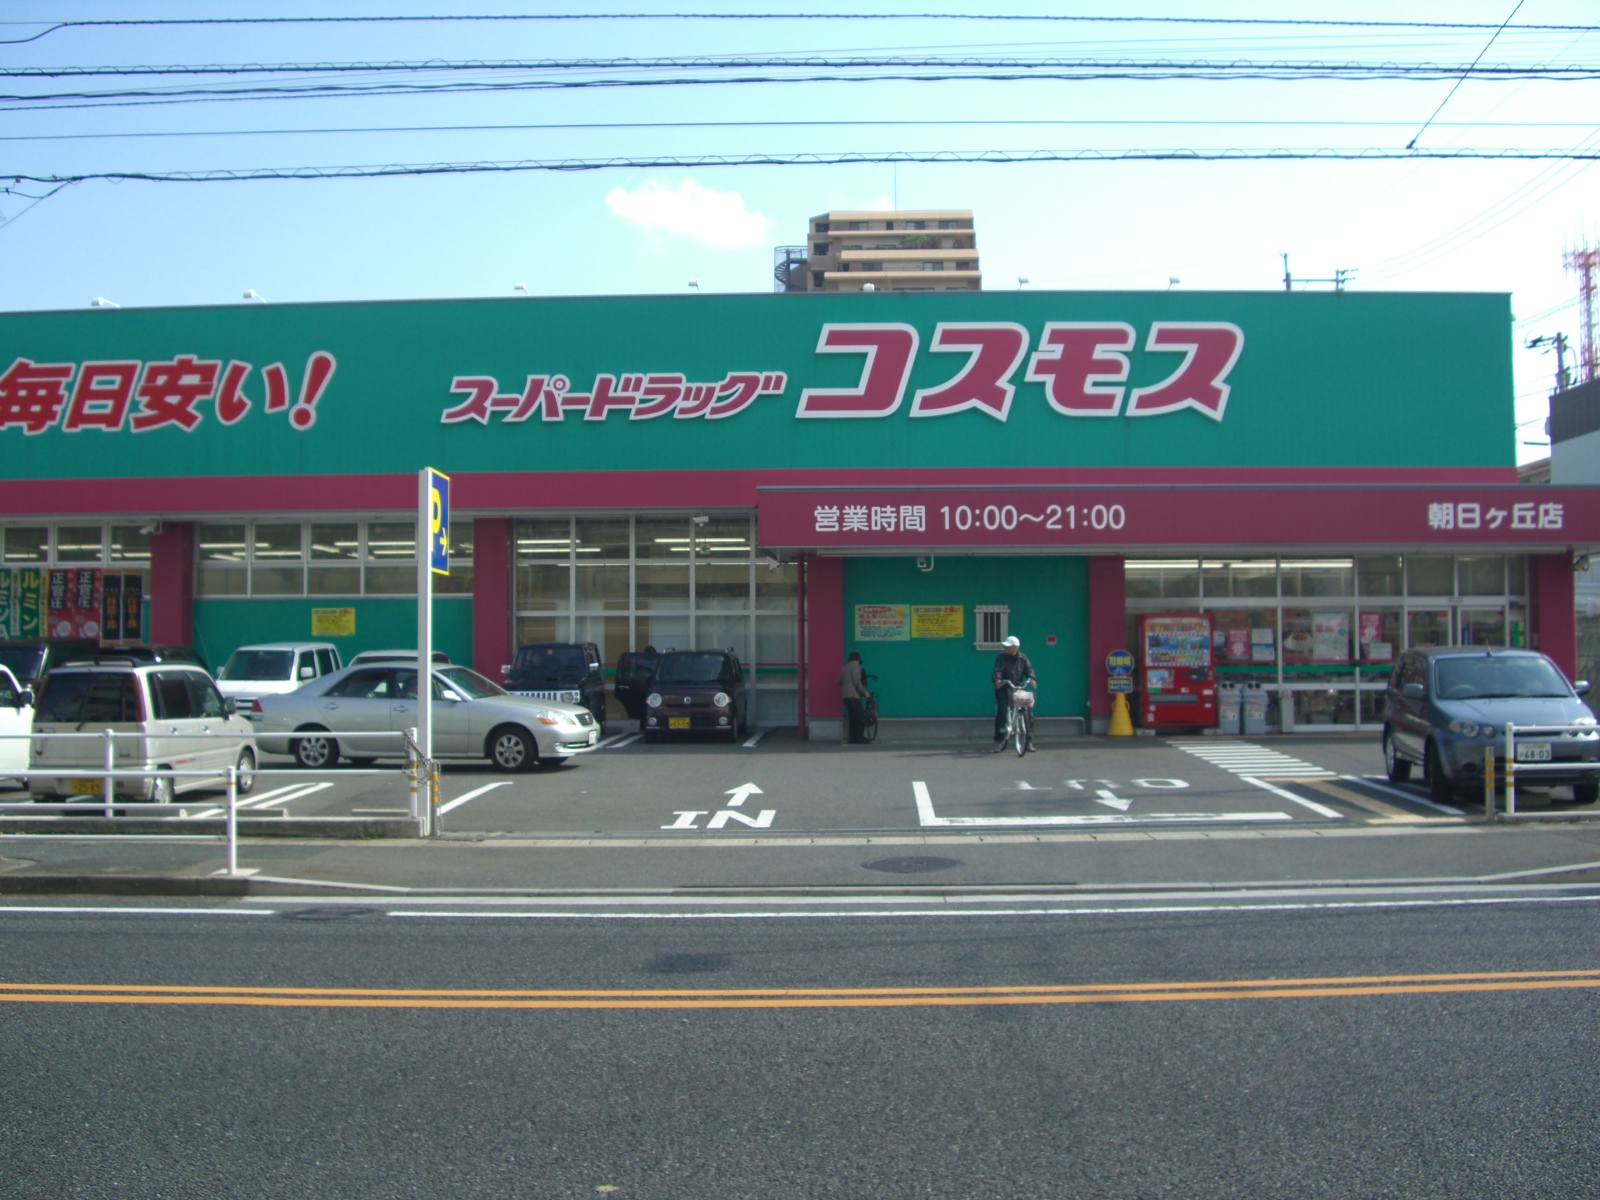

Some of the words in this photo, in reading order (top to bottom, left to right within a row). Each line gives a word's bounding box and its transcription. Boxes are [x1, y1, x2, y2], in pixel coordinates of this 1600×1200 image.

[0, 351, 336, 436] 毎日安い!
[440, 371, 787, 426] スーパードラッグ
[795, 321, 1245, 423] コスモス
[431, 487, 441, 553] P
[814, 505, 926, 532] 営業時間
[22, 571, 39, 638] ルミン
[660, 809, 776, 829] IN
